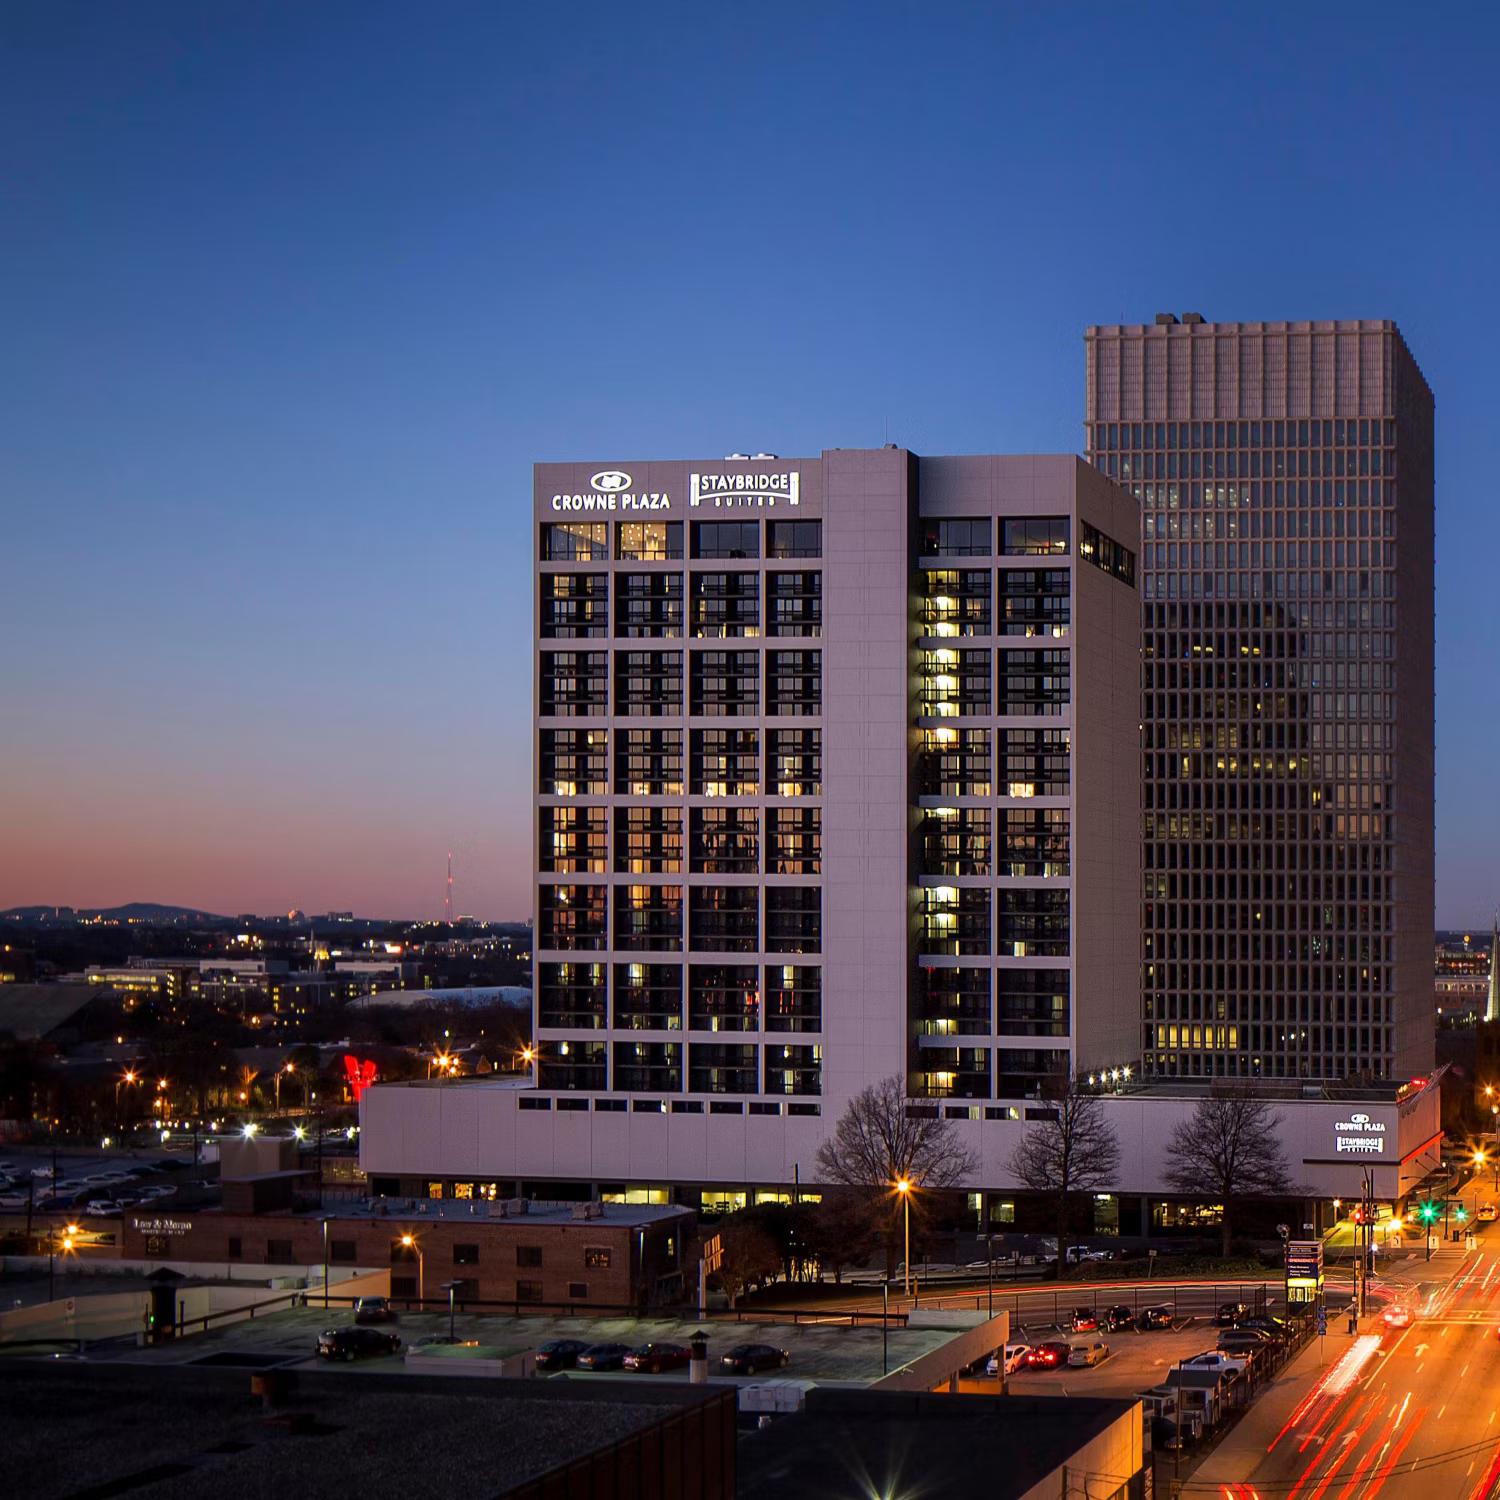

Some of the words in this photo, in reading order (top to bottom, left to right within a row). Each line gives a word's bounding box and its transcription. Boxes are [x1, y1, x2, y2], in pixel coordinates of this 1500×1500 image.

[700, 474, 789, 491] STAYBRIDGE
[552, 494, 617, 511] CROWNE
[622, 493, 671, 510] PLAZA
[714, 497, 776, 507] SUITES
[1334, 1122, 1363, 1131] CROWNE
[1363, 1122, 1386, 1132] PLAZA
